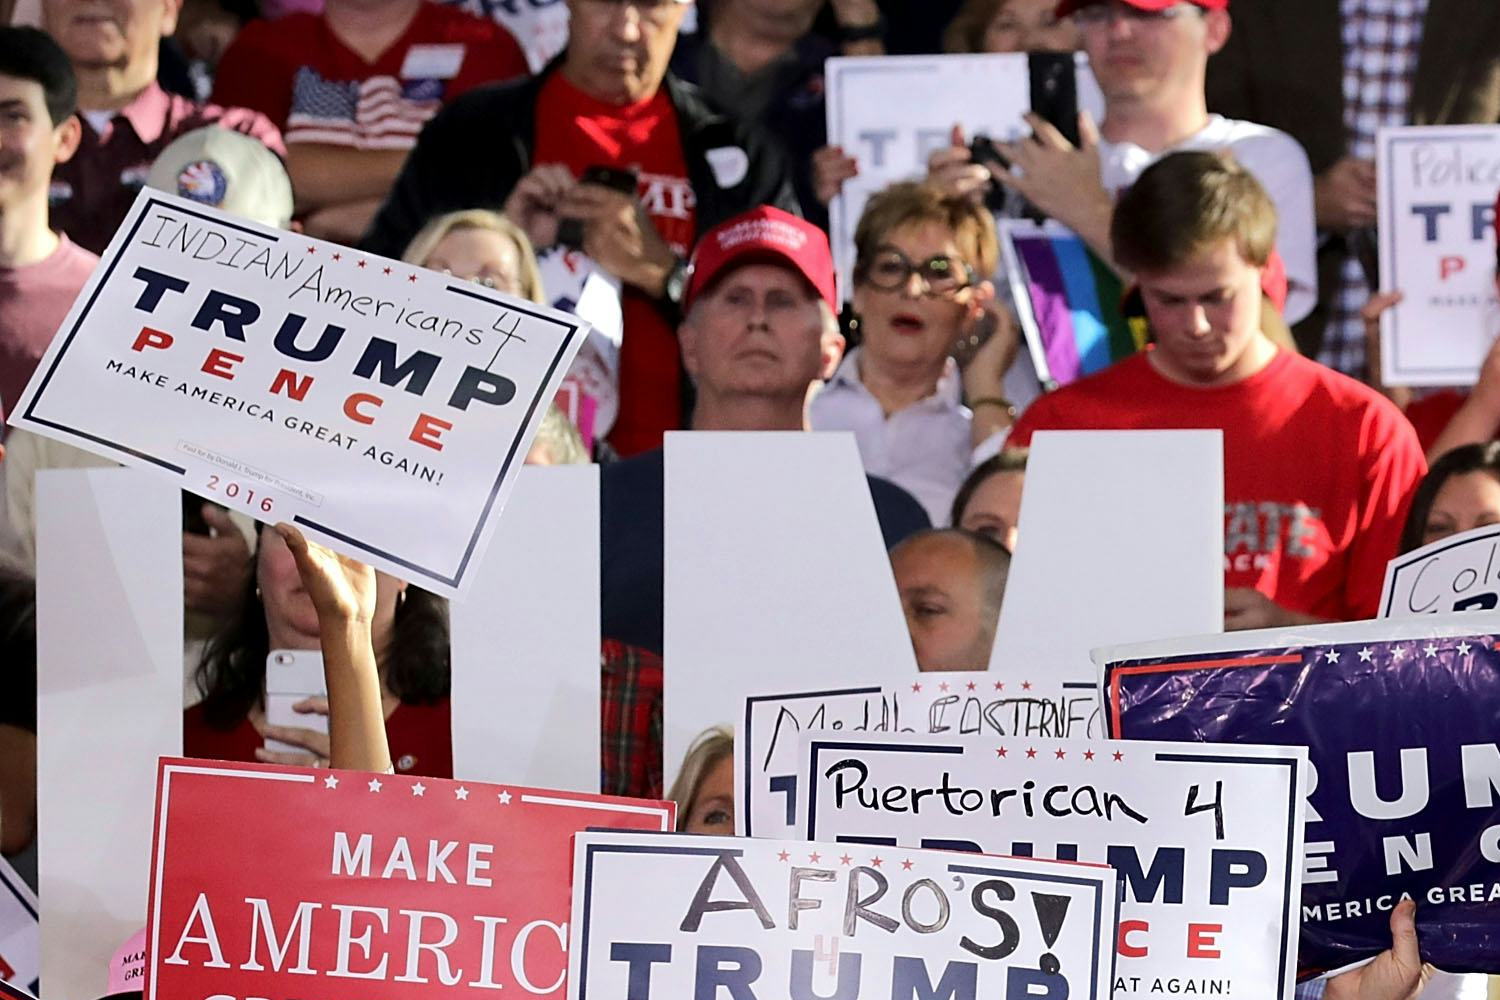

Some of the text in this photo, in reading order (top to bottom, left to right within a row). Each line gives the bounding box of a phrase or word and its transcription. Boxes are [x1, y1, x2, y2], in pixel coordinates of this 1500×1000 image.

[132, 266, 517, 411] TRUMP
[141, 214, 526, 372] INDIAN Americans 4
[106, 359, 444, 486] MAKE AMERICA GREAT AGAIN!
[132, 326, 453, 451] PENCE
[207, 475, 273, 512] 2016
[825, 758, 1149, 824] Puertorican
[1184, 780, 1226, 840] 4
[331, 831, 494, 888] MAKE
[164, 892, 568, 995] AMERIC
[1302, 891, 1415, 923] MERICA
[1150, 978, 1232, 996] AGAIN!
